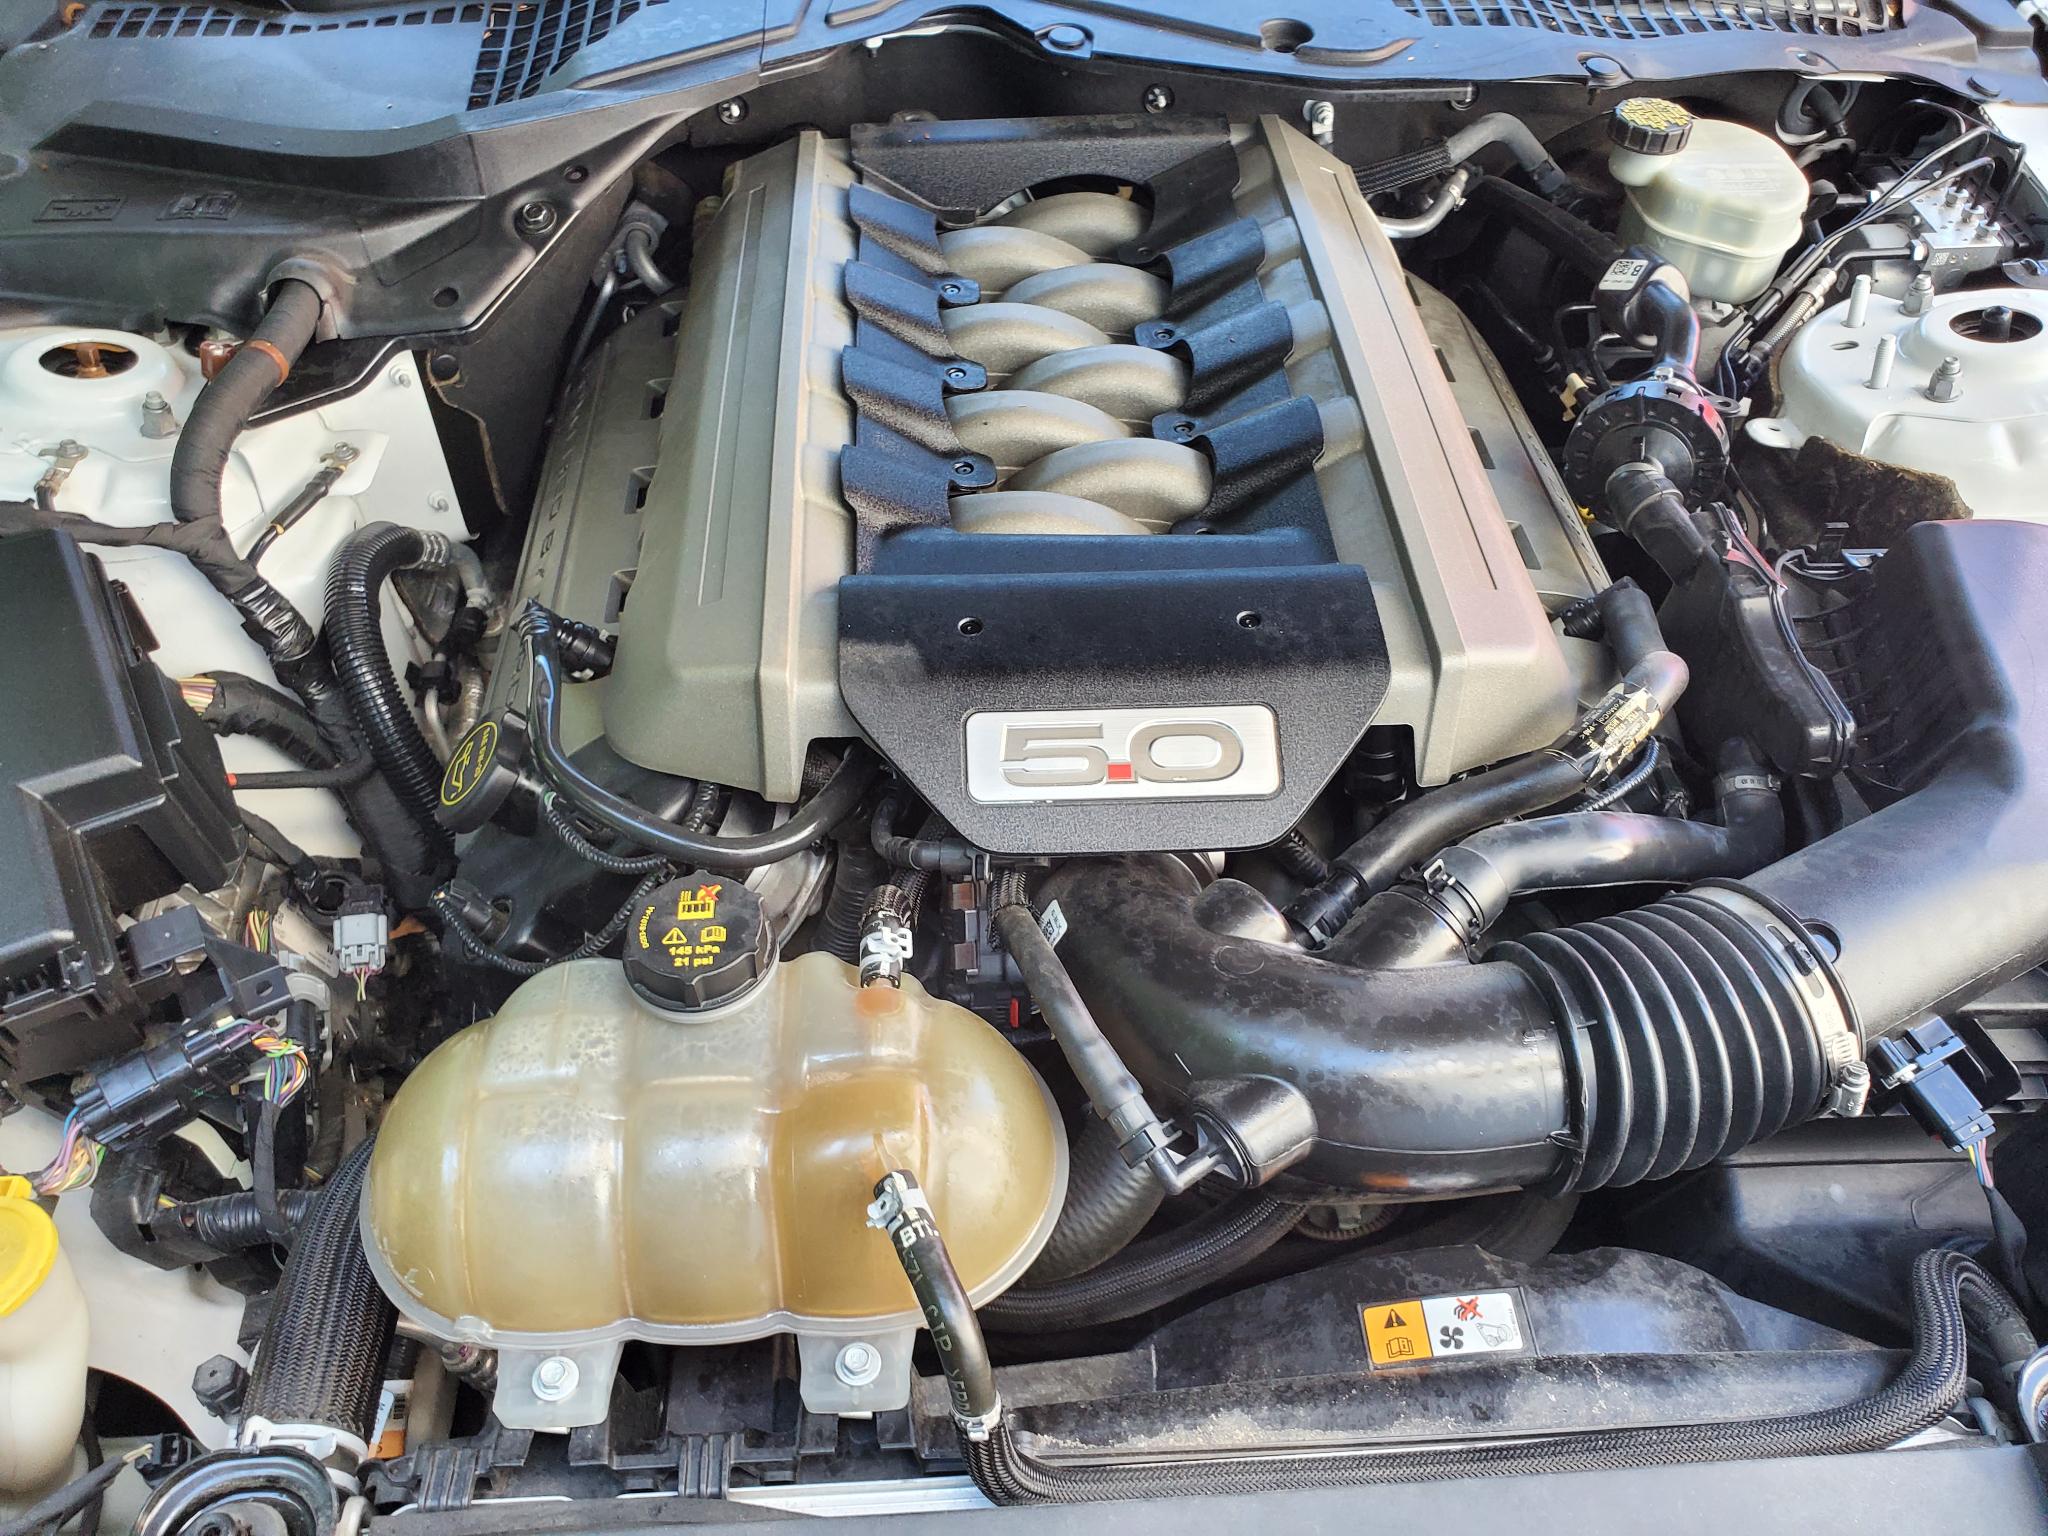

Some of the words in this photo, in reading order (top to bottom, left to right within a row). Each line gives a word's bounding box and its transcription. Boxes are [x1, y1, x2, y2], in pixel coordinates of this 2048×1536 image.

[1000, 718, 1244, 787] 5.0
[669, 945, 693, 956] 145
[695, 944, 721, 954] kPa
[674, 957, 690, 967] 21
[693, 956, 714, 967] psi
